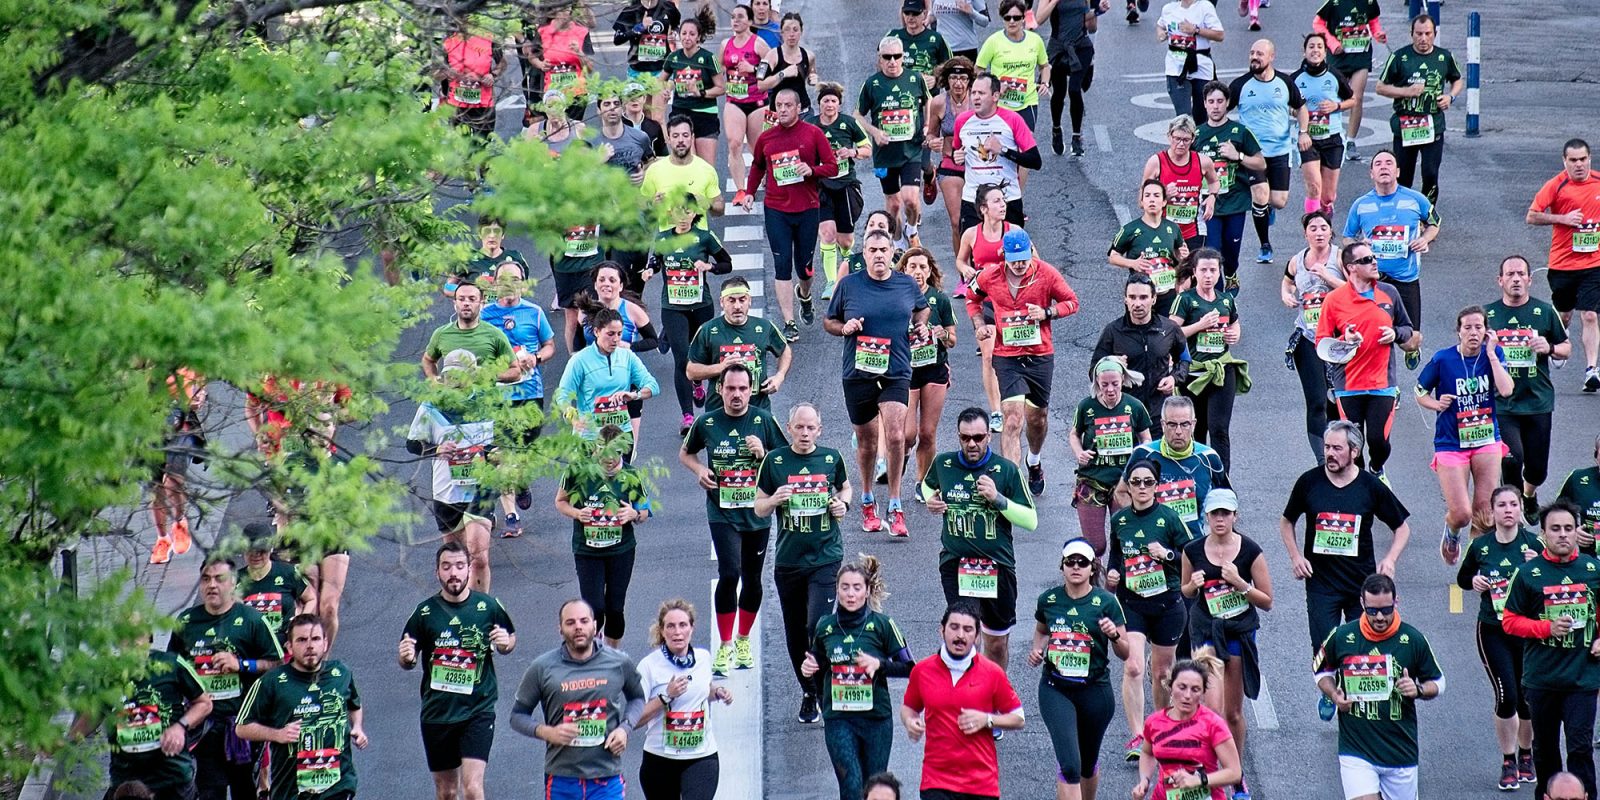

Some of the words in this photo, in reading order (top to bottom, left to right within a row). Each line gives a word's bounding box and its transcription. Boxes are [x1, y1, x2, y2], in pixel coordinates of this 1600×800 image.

[1457, 395, 1475, 407] FOR
[1476, 391, 1490, 402] THE
[731, 491, 750, 501] 42804
[801, 497, 820, 507] 41756
[1326, 536, 1346, 546] 42572
[971, 579, 989, 588] 41644
[445, 672, 466, 684] 42859
[1358, 681, 1379, 691] 42659
[293, 705, 321, 714] MADRID
